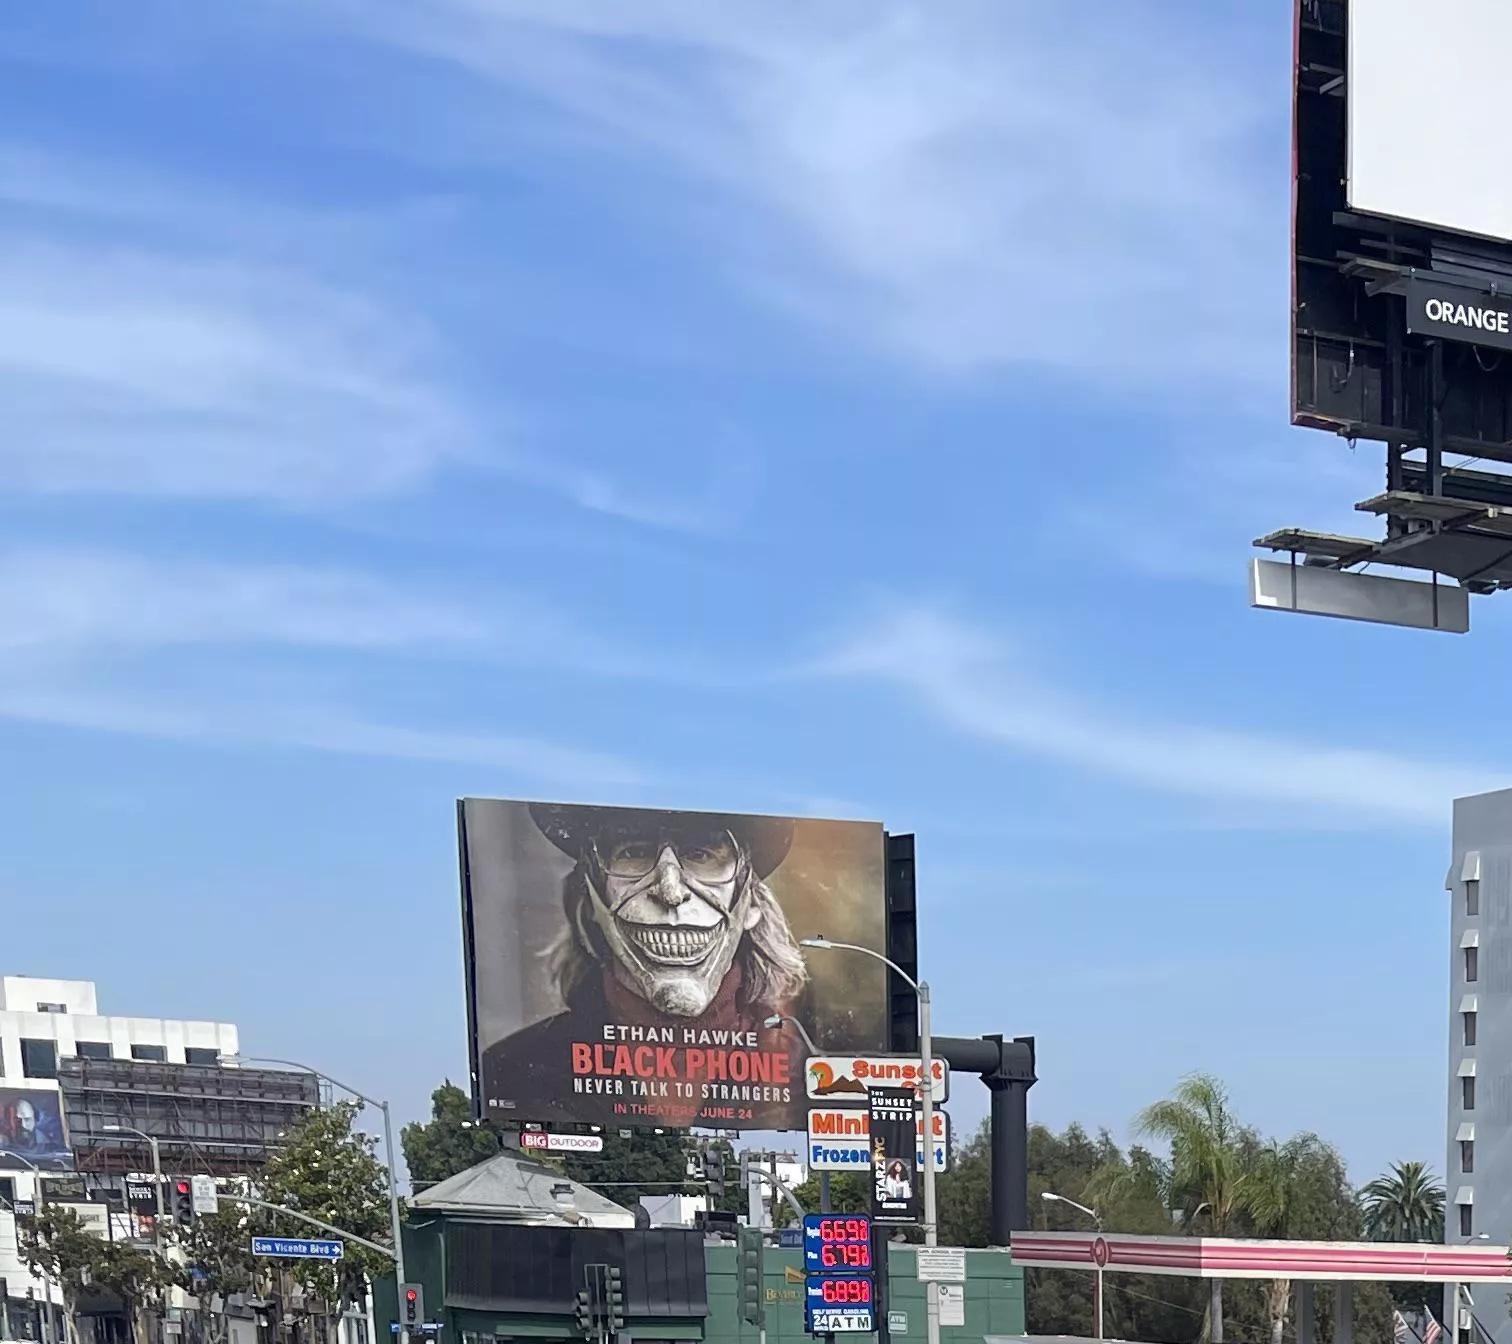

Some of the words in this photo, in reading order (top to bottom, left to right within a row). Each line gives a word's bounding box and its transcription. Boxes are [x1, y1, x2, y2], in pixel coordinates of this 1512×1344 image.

[1425, 298, 1510, 334] ORANGE
[603, 1024, 674, 1043] ETHAN
[683, 1029, 758, 1047] HAWKE
[571, 1042, 677, 1078] BLACK
[685, 1048, 791, 1084] PHONE
[573, 1077, 624, 1096] NEVER
[631, 1079, 669, 1097] TALK
[675, 1082, 693, 1098] TO
[701, 1083, 791, 1104] STRANGERS
[871, 1097, 913, 1107] SUNSET
[613, 1103, 627, 1114] IN
[629, 1103, 697, 1118] THEATERS
[699, 1106, 735, 1119] JUNE
[738, 1108, 753, 1120] 24
[872, 1111, 913, 1121] STRIP
[812, 1113, 870, 1135] Mini
[525, 1135, 547, 1148] BIG
[549, 1137, 599, 1149] OUTDOOR
[812, 1145, 870, 1163] Frozen
[875, 1161, 887, 1202] STARZ
[255, 1242, 272, 1252] San
[275, 1243, 307, 1253] Vicente
[310, 1244, 330, 1254] Blvd
[813, 1315, 828, 1325] 24
[831, 1316, 870, 1329] ATM
